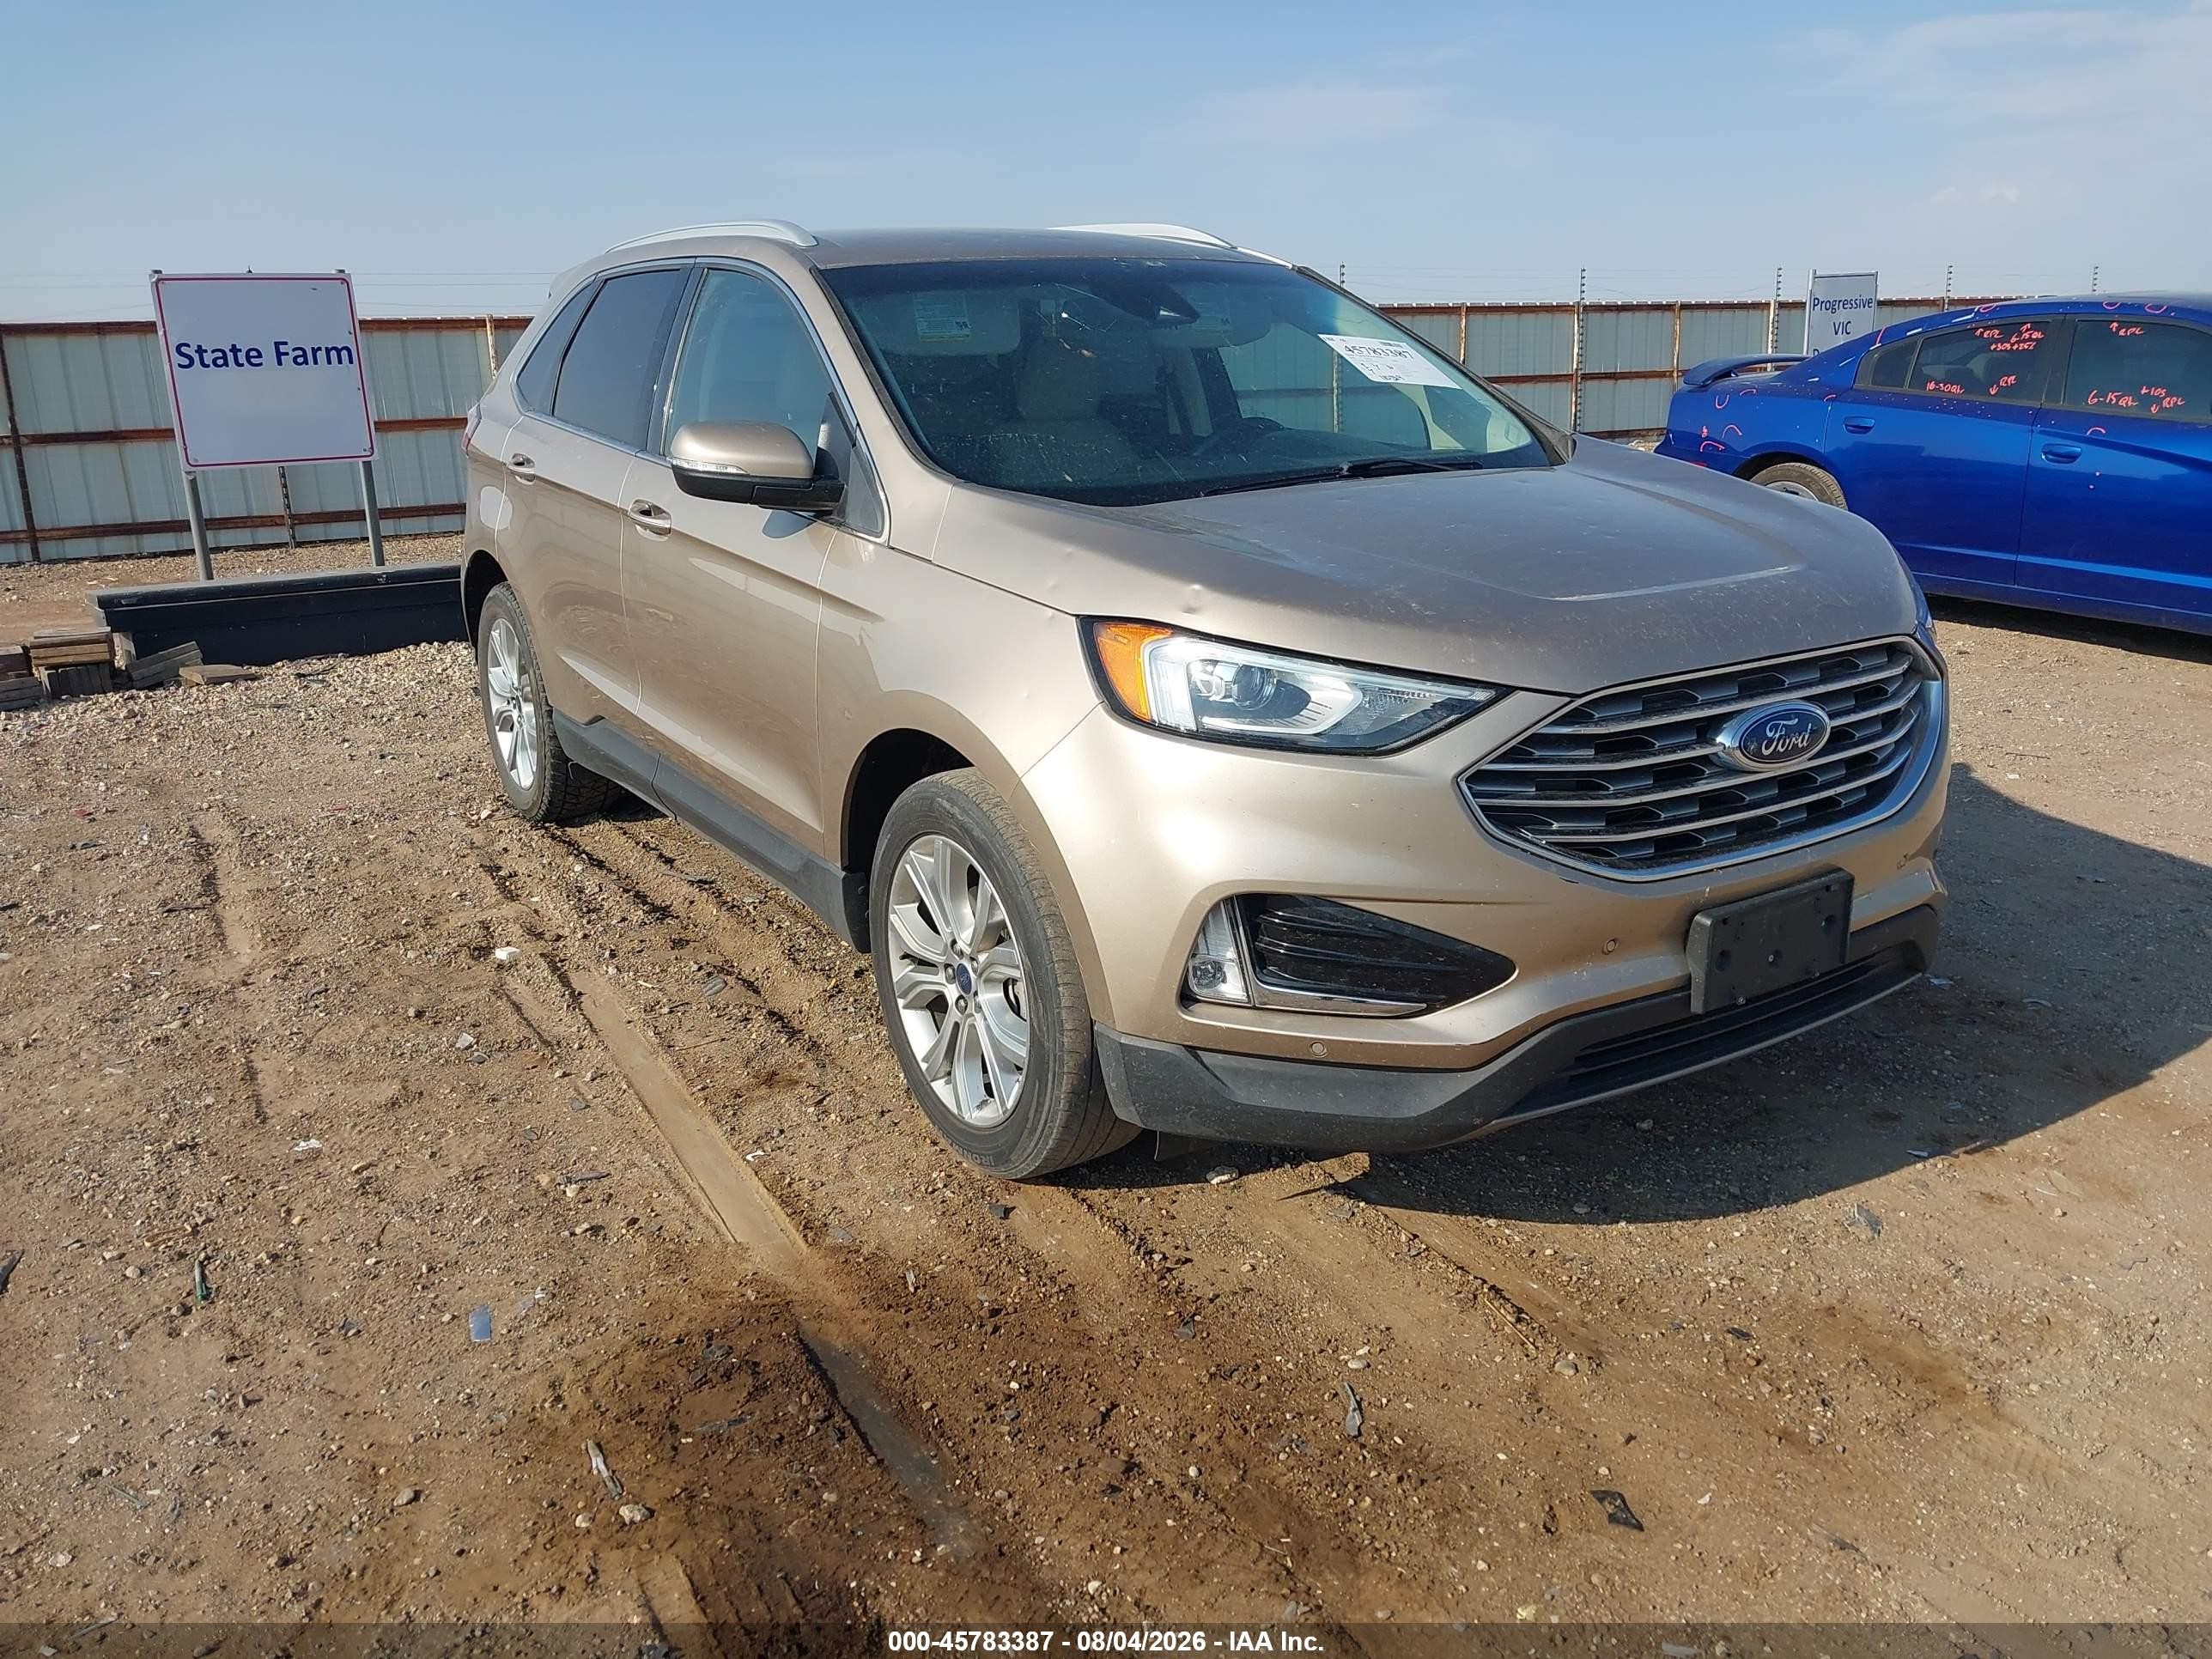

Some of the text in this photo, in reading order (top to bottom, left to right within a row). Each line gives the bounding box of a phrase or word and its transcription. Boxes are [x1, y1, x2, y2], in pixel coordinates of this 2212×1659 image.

[1813, 295, 1873, 314] Progressive
[1832, 320, 1851, 336] VIC
[175, 340, 355, 369] State Farm
[1345, 345, 1414, 360] 45783387
[1761, 717, 1812, 756] Ford
